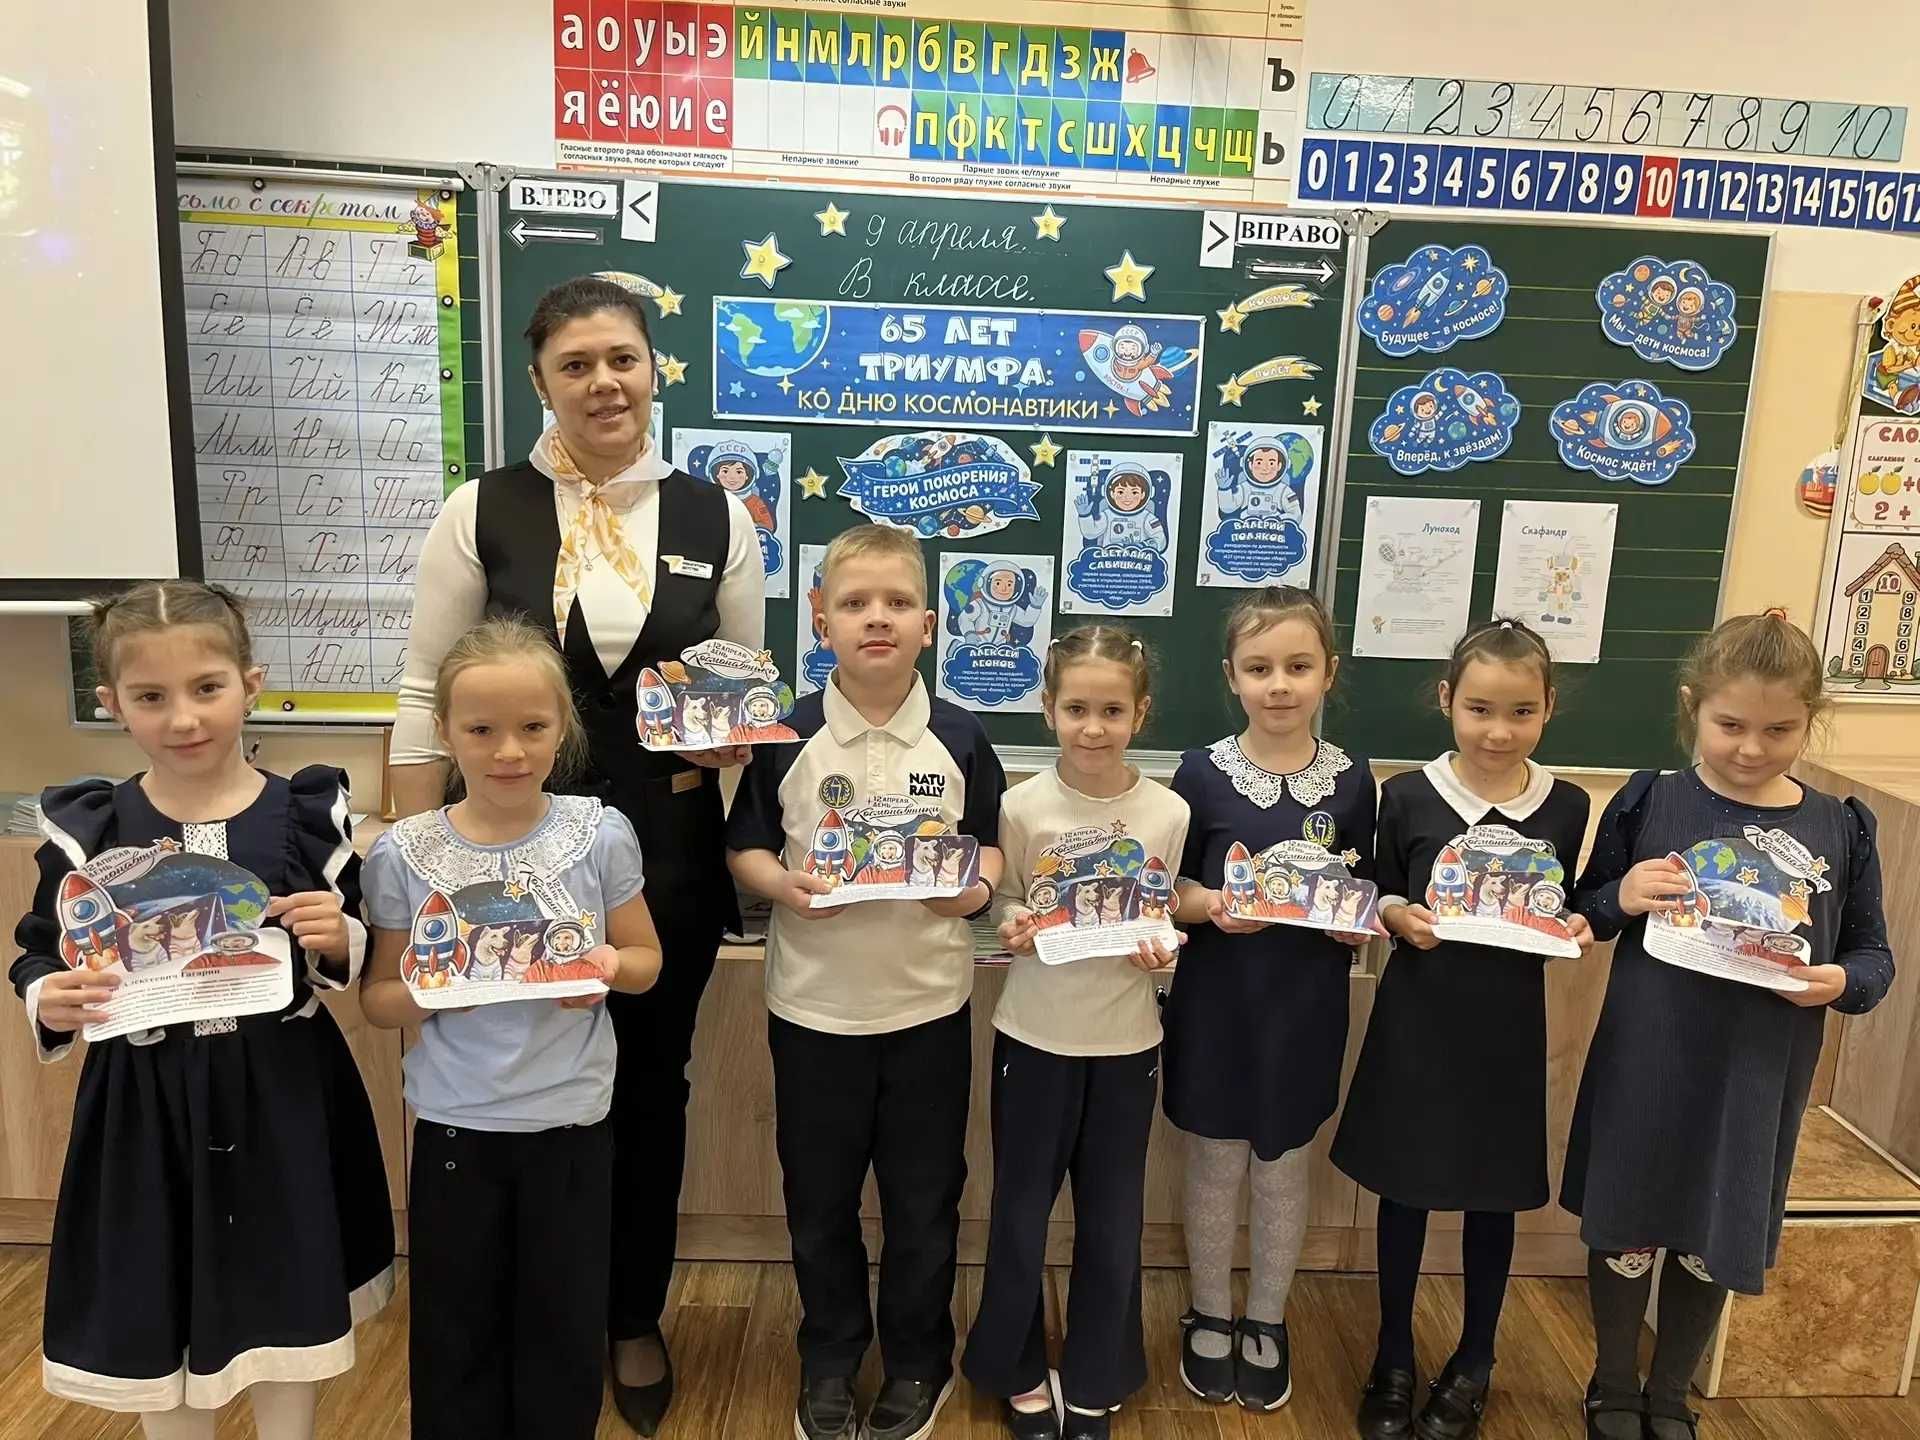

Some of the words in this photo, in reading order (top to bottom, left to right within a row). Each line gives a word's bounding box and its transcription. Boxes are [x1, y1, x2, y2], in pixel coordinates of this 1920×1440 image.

[1324, 74, 1360, 130] 0
[1383, 78, 1413, 131] 1
[1424, 80, 1462, 135] 2
[1475, 83, 1513, 136] 3
[1530, 85, 1563, 139] 4
[1575, 88, 1614, 140] 5
[1622, 91, 1662, 144] 6
[1683, 94, 1712, 146] 7
[1724, 98, 1760, 150] 8
[1772, 101, 1810, 153] 9
[1828, 105, 1892, 159] 10
[561, 144, 592, 152] Гласные
[594, 147, 624, 155] второго
[626, 150, 645, 158] ряда
[647, 149, 692, 159] обозначают
[694, 153, 728, 162] мягкость
[564, 152, 602, 162] согласных
[605, 156, 632, 165] звуков,
[634, 157, 656, 165] после
[658, 160, 690, 168] которых
[692, 161, 724, 170] следуют
[782, 154, 824, 165] Непарные
[826, 158, 859, 166] звонкие
[963, 165, 994, 175] Парные
[910, 174, 920, 182] Во
[922, 176, 952, 185] втором
[954, 178, 973, 188] ряду
[975, 179, 1002, 188] глухие
[1005, 180, 1046, 190] согласные
[1150, 175, 1191, 186] Непарные
[1193, 178, 1220, 188] глухие
[1308, 149, 1328, 190] 0
[1345, 151, 1358, 191] 1
[1375, 153, 1395, 193] 2
[1409, 154, 1429, 196] 3
[1443, 157, 1463, 197] 4
[1476, 158, 1497, 199] 5
[1511, 160, 1531, 201] 6
[1546, 162, 1566, 202] 7
[1578, 163, 1600, 204] 8
[1613, 165, 1634, 205] 9
[1646, 166, 1672, 208] 10
[1682, 169, 1710, 210] 11
[1720, 172, 1748, 212] 12
[1756, 174, 1782, 214] 13
[1792, 177, 1820, 216] 14
[1828, 179, 1858, 218] 15
[1864, 181, 1894, 222] 16
[520, 186, 606, 210] ВЛЕВО
[178, 193, 241, 212] сьмо
[250, 197, 262, 212] с
[270, 193, 400, 226] секретом
[866, 214, 887, 247] 9
[1242, 221, 1340, 245] ВПРАВО
[838, 257, 872, 298] В
[1248, 292, 1298, 308] КОСМОС
[1382, 330, 1430, 346] Будущее
[1444, 326, 1450, 336] в
[1452, 300, 1500, 332] космосе!
[880, 314, 926, 343] 65
[944, 316, 1016, 346] ЛЕТ
[1608, 314, 1626, 332] Мы
[1634, 332, 1660, 350] дети
[1662, 342, 1710, 358] космоса!
[798, 390, 831, 410] КО
[838, 390, 897, 415] ДНЮ
[904, 394, 1098, 420] КОСМОНАВТИКИ
[1879, 426, 1920, 444] СЛО
[719, 444, 746, 454] СССР
[1397, 449, 1442, 464] Вперёд,
[1444, 448, 1451, 458] к
[1453, 430, 1503, 456] звёздам!
[1576, 444, 1618, 468] Космос
[1620, 459, 1656, 472] ждёт!
[873, 483, 920, 498] ГЕРОИ
[923, 470, 1008, 492] ПОКОРЕНИЯ
[909, 484, 979, 510] КОСМОСА
[1874, 501, 1889, 520] 2
[1234, 522, 1286, 531] ВАЛЕРИЙ
[1422, 522, 1460, 535] Луноход
[1522, 526, 1568, 539] Скафандр
[1231, 532, 1286, 543] ПОЛЯКОВ
[1092, 548, 1153, 561] СВЕТЛАНА
[1088, 561, 1152, 572] САВИЦКАЯ
[1880, 576, 1899, 590] 10
[1862, 591, 1869, 600] 1
[1906, 592, 1913, 602] 9
[1860, 606, 1868, 617] 2
[1904, 608, 1911, 618] 8
[1858, 624, 1866, 634] 3
[1902, 624, 1910, 634] 7
[713, 642, 721, 650] 12
[720, 644, 747, 658] АПРЕЛЯ
[1854, 640, 1862, 650] 4
[1900, 640, 1907, 650] 6
[710, 648, 728, 658] ДЕНЬ
[970, 649, 1019, 658] АЛЕКСЕЙ
[972, 659, 1016, 669] ЛЕОНОВ
[1853, 655, 1860, 666] 5
[1897, 656, 1905, 666] 5
[909, 772, 945, 786] NATU
[909, 785, 945, 798] RALLY
[882, 796, 909, 804] АПРЕЛЯ
[844, 804, 941, 821] Космонавтики
[1488, 828, 1514, 837] АПРЕЛЯ
[1780, 833, 1789, 841] 12
[1774, 838, 1791, 852] ДЕНЬ
[82, 865, 96, 873] 12
[96, 849, 131, 868] АПРЕЛЯ
[88, 865, 113, 878] ДЕНЬ
[181, 969, 220, 978] Гагарин
